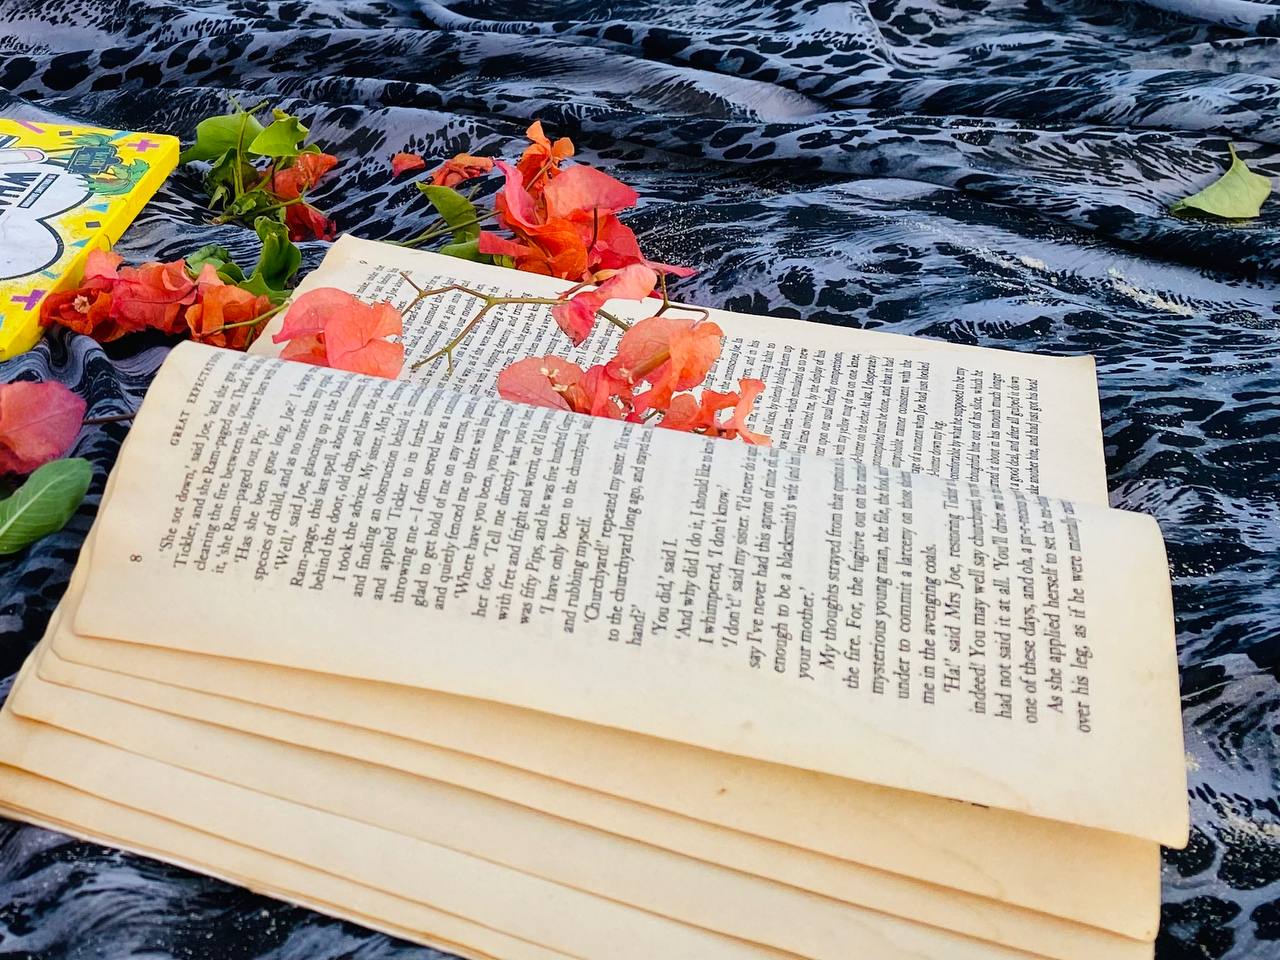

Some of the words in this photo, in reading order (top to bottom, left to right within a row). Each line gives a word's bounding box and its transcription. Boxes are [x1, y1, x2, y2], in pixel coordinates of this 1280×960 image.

[169, 410, 189, 446] GREAT
[201, 418, 232, 475] Ram-paged
[218, 437, 244, 479] between
[279, 467, 293, 488] and
[357, 461, 377, 479] My
[371, 450, 399, 504] obstruction
[195, 477, 212, 496] she
[212, 482, 230, 500] fire
[311, 477, 330, 495] last
[348, 482, 368, 518] advice.
[191, 497, 205, 519] and
[266, 490, 287, 521] child,
[306, 497, 323, 519] this
[386, 482, 408, 520] Tickler
[263, 521, 277, 536] of
[423, 510, 443, 536] hold
[444, 503, 465, 540] fenced
[476, 563, 495, 590] foot.
[494, 468, 519, 505] directly
[507, 510, 529, 542] fright
[619, 506, 642, 531] long
[172, 521, 200, 568] Tickler,
[193, 523, 220, 570] clearing
[308, 548, 332, 590] behind
[325, 493, 347, 523] door,
[354, 525, 381, 569] finding
[379, 526, 397, 570] applied
[423, 540, 438, 559] get
[575, 516, 592, 557] myself.
[129, 554, 143, 563] 8
[253, 538, 273, 580] species
[289, 523, 319, 587] Ram-page,
[337, 543, 353, 571] took
[419, 562, 431, 575] to
[438, 541, 459, 583] quietly
[524, 543, 545, 572] Pips,
[609, 532, 634, 602] churchyard
[751, 554, 769, 577] had
[825, 539, 845, 581] strayed
[919, 543, 936, 573] coals.
[352, 574, 367, 597] and
[372, 577, 387, 600] and
[389, 546, 417, 603] throwing
[498, 568, 517, 589] fret
[519, 574, 541, 599] fifty
[564, 559, 589, 607] rubbing
[944, 563, 964, 589] Joe,
[1040, 565, 1059, 608] herself
[410, 579, 428, 607] glad
[753, 580, 766, 615] never
[875, 576, 892, 618] young
[895, 581, 912, 633] commit
[920, 576, 941, 635] avenging
[944, 591, 960, 619] Mrs
[519, 602, 532, 624] was
[819, 583, 843, 640] thoughts
[974, 597, 990, 626] may
[1017, 603, 1040, 636] days,
[771, 622, 792, 673] enough
[843, 634, 860, 662] fire.
[918, 638, 935, 660] the
[943, 625, 960, 653] said
[968, 629, 985, 657] You
[993, 630, 1011, 659] said
[1042, 612, 1066, 663] applied
[749, 645, 766, 668] say
[818, 644, 840, 669] My
[872, 619, 889, 694] mysterious
[1018, 639, 1036, 675] these
[1069, 645, 1093, 669] leg,
[842, 666, 859, 688] the
[892, 656, 910, 699] under
[923, 665, 935, 679] in
[998, 663, 1011, 687] not
[1018, 677, 1036, 693] of
[1044, 667, 1062, 691] she
[1071, 675, 1088, 695] his
[922, 682, 934, 704] me
[968, 661, 986, 714] indeed!
[993, 693, 1012, 719] had
[1025, 697, 1037, 723] one
[1046, 695, 1063, 713] As
[1077, 700, 1091, 733] over
